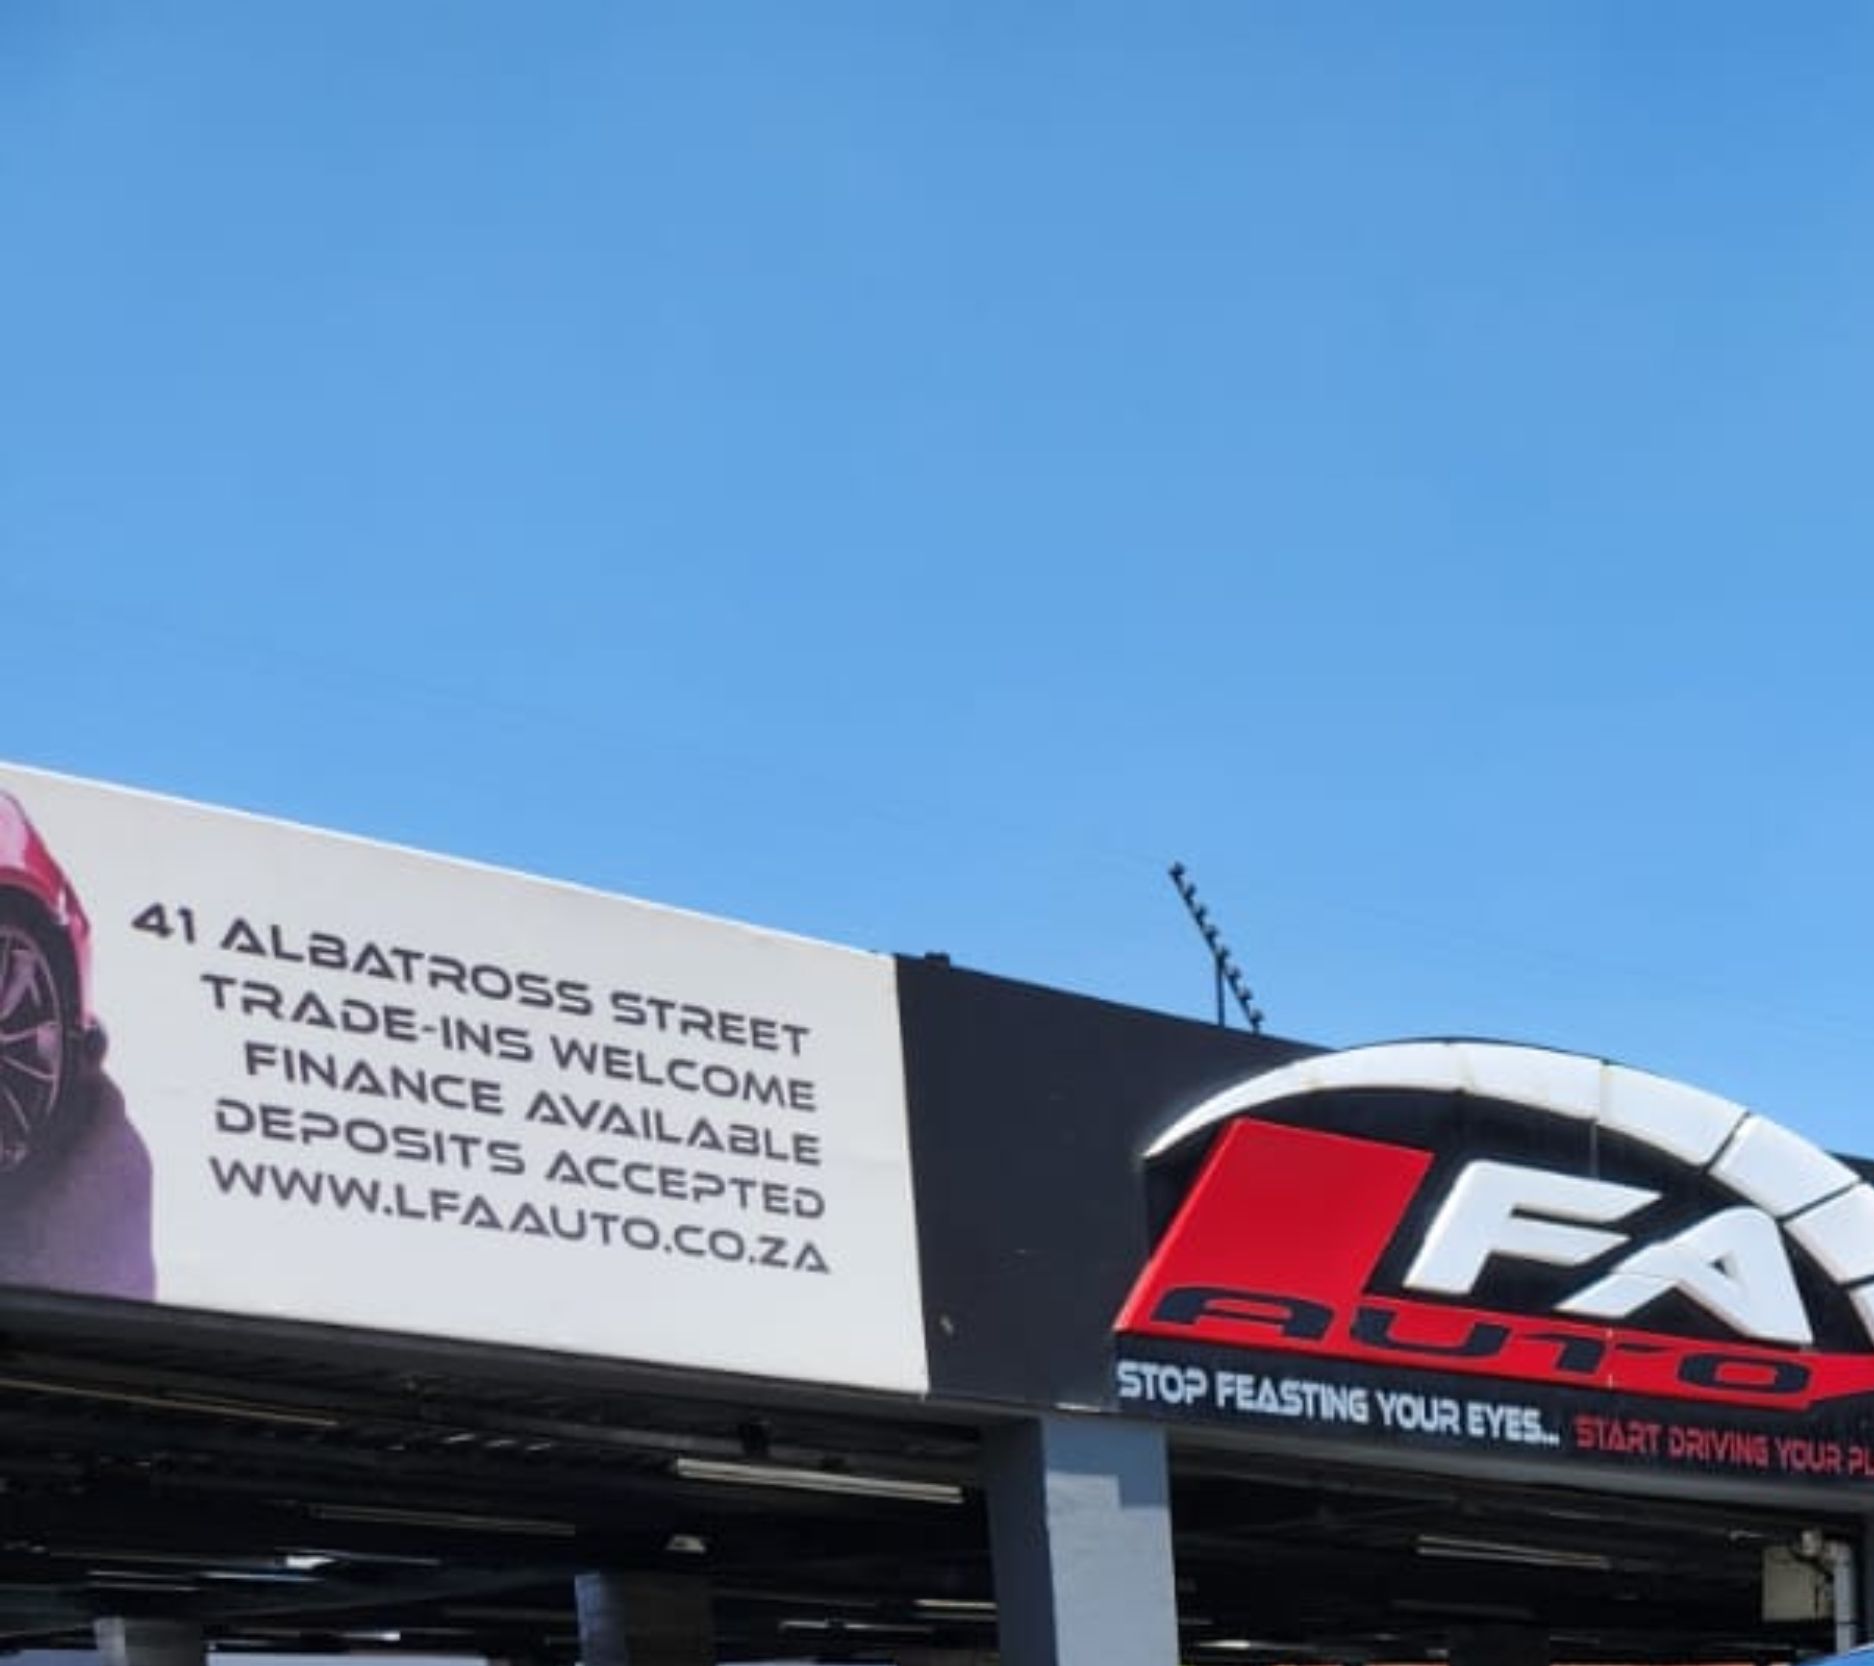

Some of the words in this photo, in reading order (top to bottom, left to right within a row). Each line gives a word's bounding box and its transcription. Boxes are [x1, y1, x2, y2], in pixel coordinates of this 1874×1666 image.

[131, 902, 197, 946] 41
[219, 917, 595, 1017] ALBATROSS
[610, 990, 811, 1057] STREET
[201, 974, 534, 1063] TRADE-INS
[550, 1035, 818, 1113] WELCOME
[215, 1099, 527, 1176] DEPOSITS
[544, 1150, 827, 1221] ACCEPTED
[244, 1042, 504, 1115] FINANCE
[524, 1091, 822, 1167] AVAILABLE
[208, 1155, 831, 1275] WWW.LFAAUTO.CO.ZA
[1150, 1286, 1813, 1394] AUTO
[1116, 1360, 1208, 1403] STOP
[1216, 1371, 1370, 1424] FEASTING
[1376, 1390, 1460, 1434] YOUR
[1468, 1403, 1560, 1446] EYES...
[1575, 1414, 1662, 1454] START
[1668, 1425, 1770, 1467] DRIVING
[1775, 1437, 1843, 1471] YOUR
